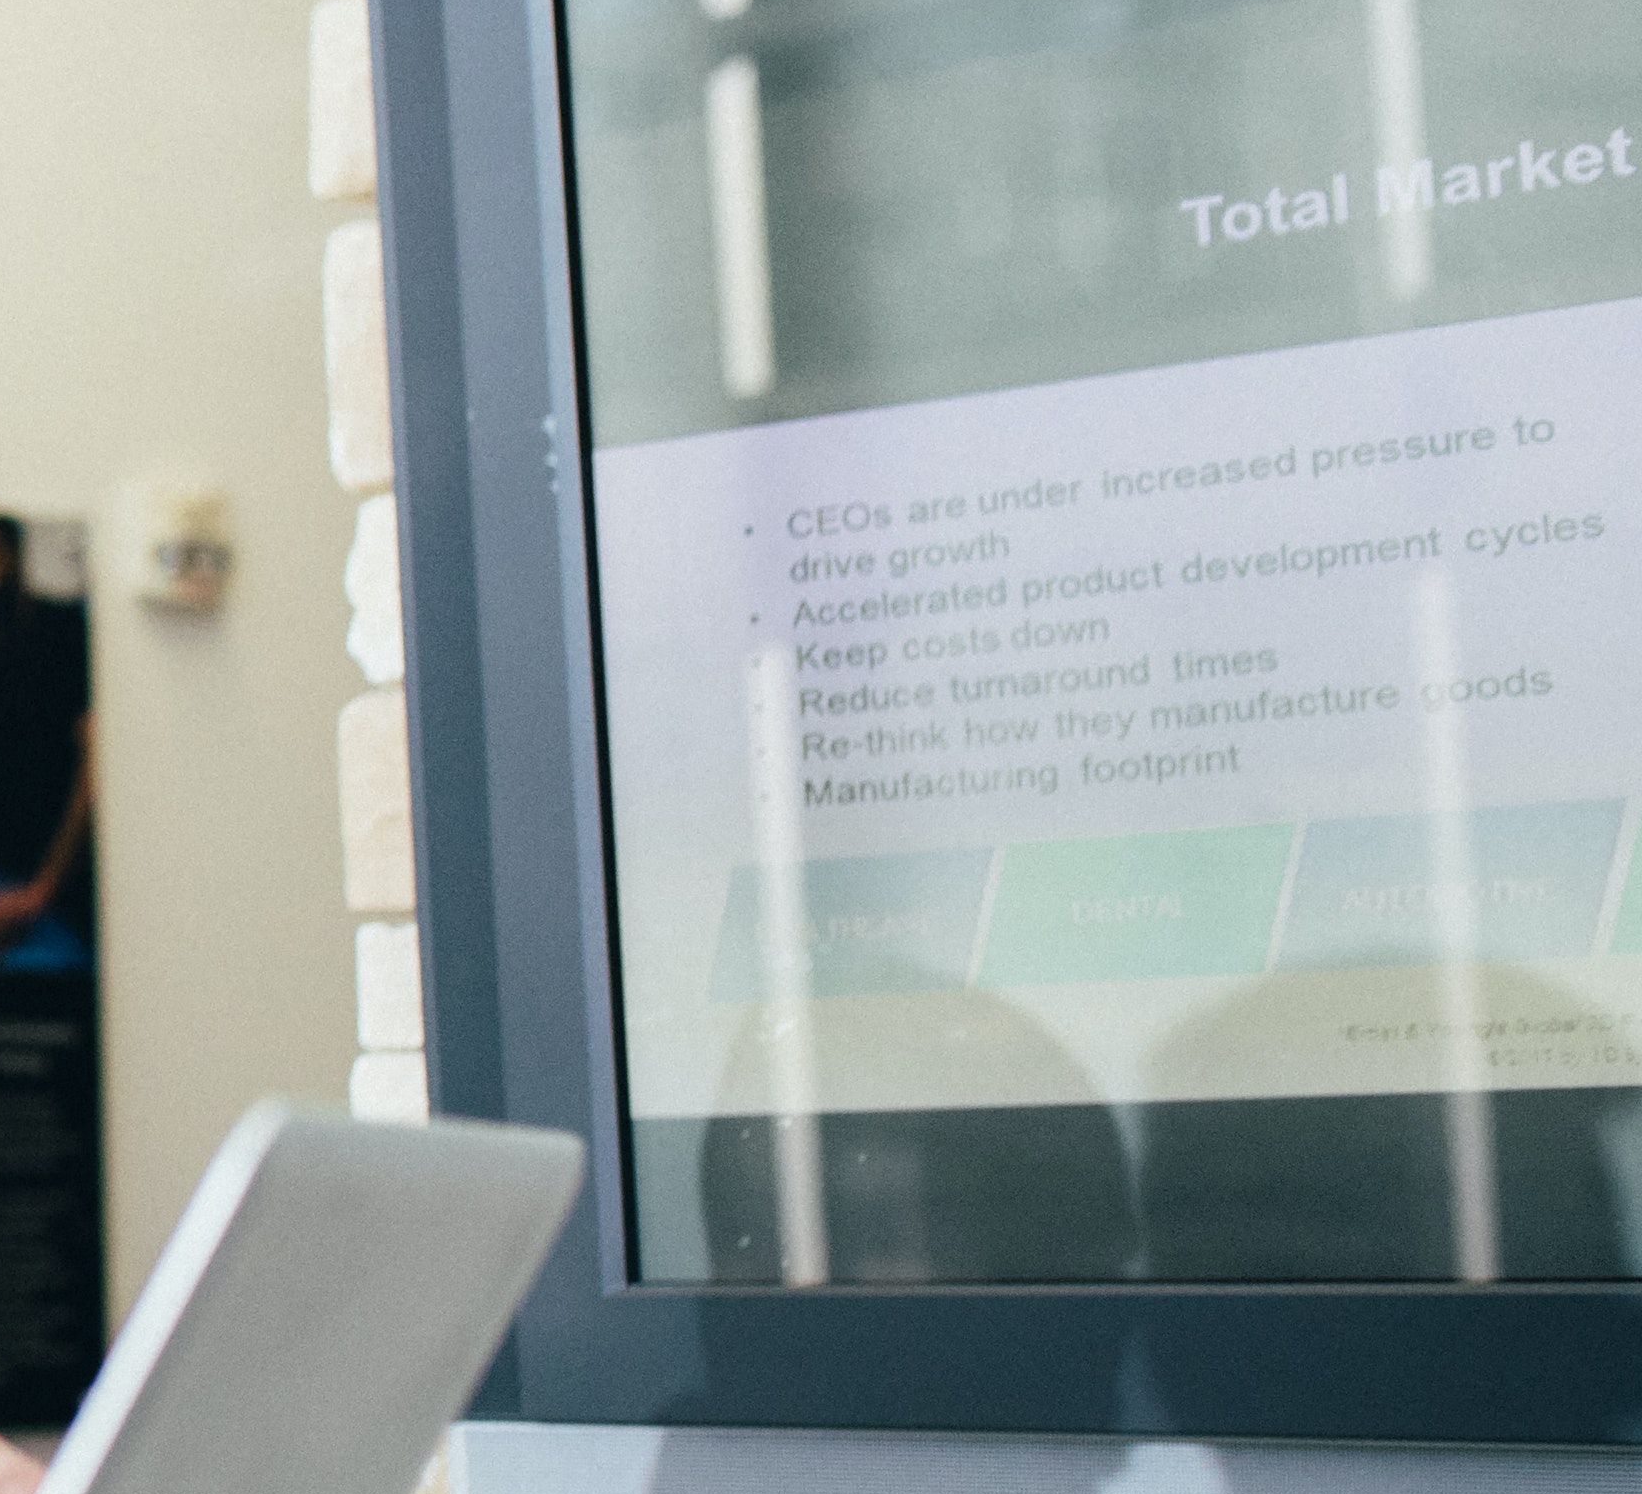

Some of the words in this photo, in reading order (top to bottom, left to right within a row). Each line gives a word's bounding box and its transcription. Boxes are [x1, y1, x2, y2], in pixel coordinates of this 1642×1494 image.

[1180, 171, 1351, 247] Total
[1376, 127, 1639, 219] Market
[787, 500, 893, 539] CEOs
[908, 492, 967, 526] are
[979, 478, 1082, 514] under
[1103, 446, 1296, 498] increased
[1312, 425, 1497, 479] pressure
[1512, 416, 1556, 447] to
[790, 548, 874, 584] drive
[889, 528, 1010, 579] growth
[793, 577, 1007, 629] Accelerated
[1023, 560, 1165, 609] product
[1181, 526, 1442, 585] development
[1465, 511, 1606, 559] cycles
[795, 639, 888, 672] Keep
[902, 626, 1001, 661] costs
[1010, 615, 1111, 650] down
[798, 676, 935, 717] Reduce
[950, 654, 1151, 704] turnaround
[1173, 646, 1279, 683] times
[802, 720, 949, 762] Re-think
[964, 716, 1041, 748] how
[1055, 707, 1136, 741] they
[1150, 684, 1401, 730] manufacture
[803, 762, 1059, 809] Manufacturing
[1082, 744, 1241, 785] footprint
